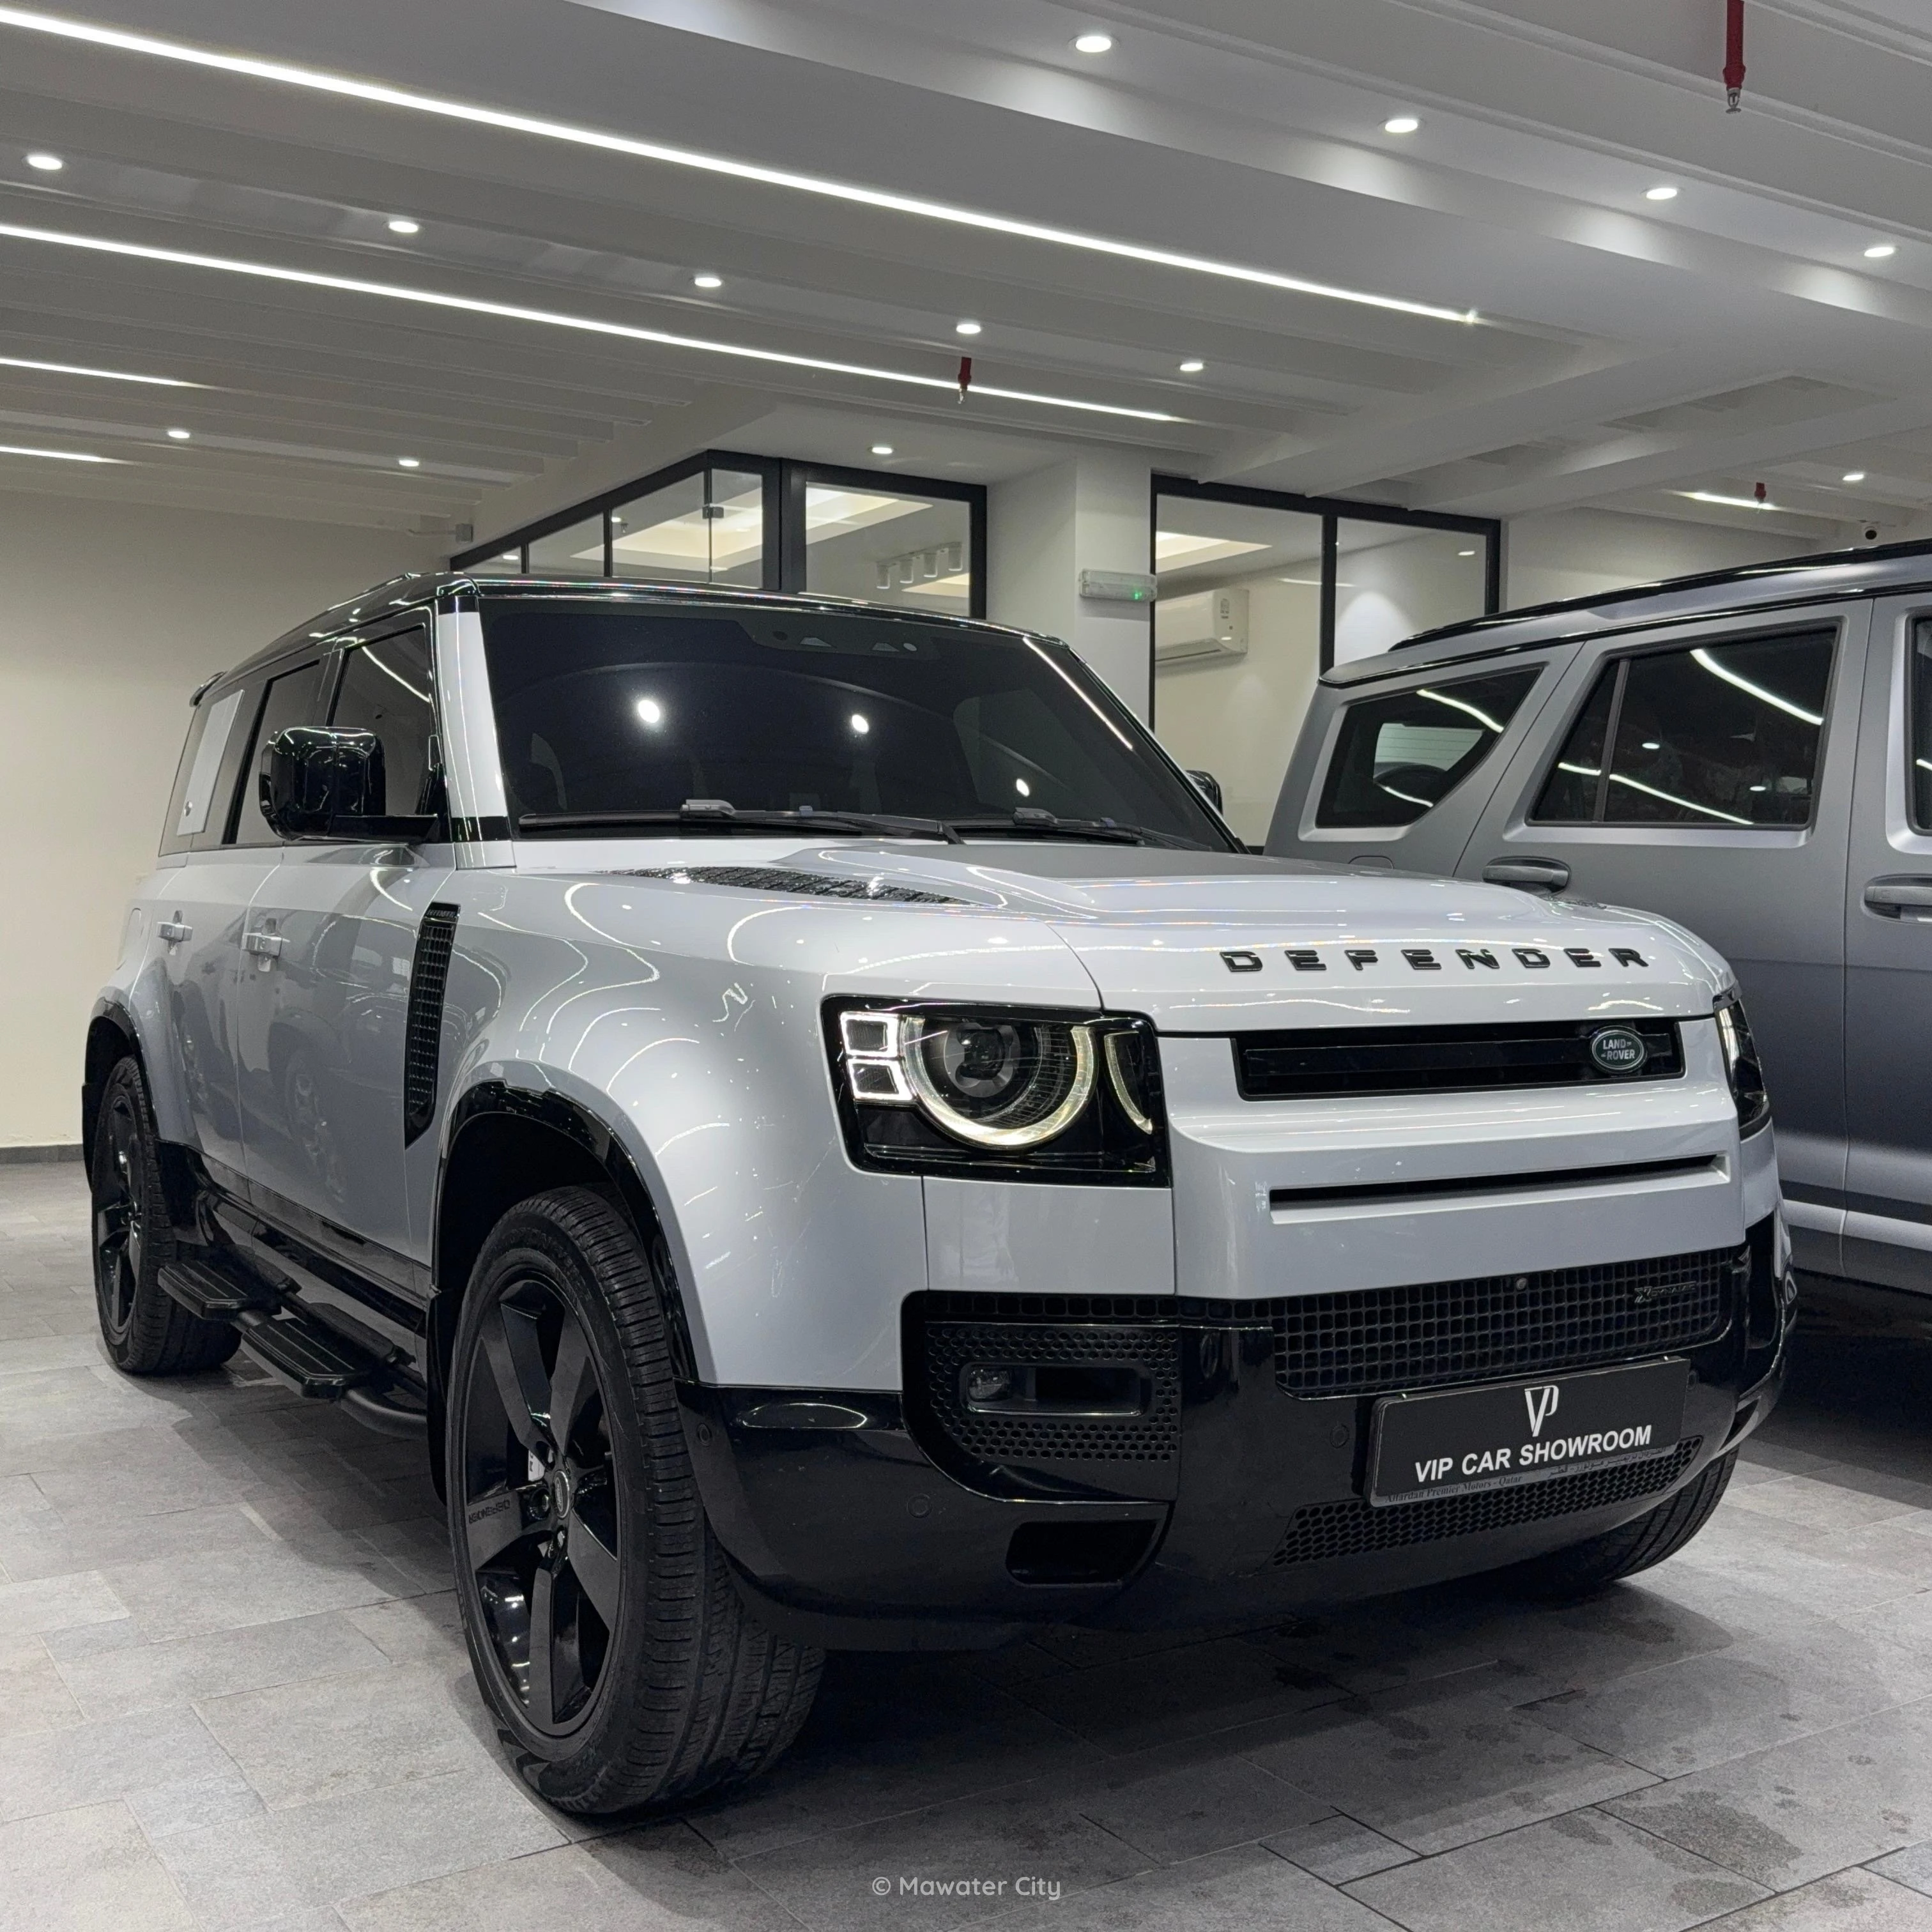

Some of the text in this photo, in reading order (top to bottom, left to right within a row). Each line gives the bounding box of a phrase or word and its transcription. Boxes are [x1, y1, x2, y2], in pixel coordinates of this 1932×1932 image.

[1220, 947, 1650, 972] DEFENDER
[1602, 1039, 1627, 1050] LAND
[1606, 1049, 1636, 1061] ROVER
[1414, 1425, 1652, 1482] VIP CAR SHOWROOM
